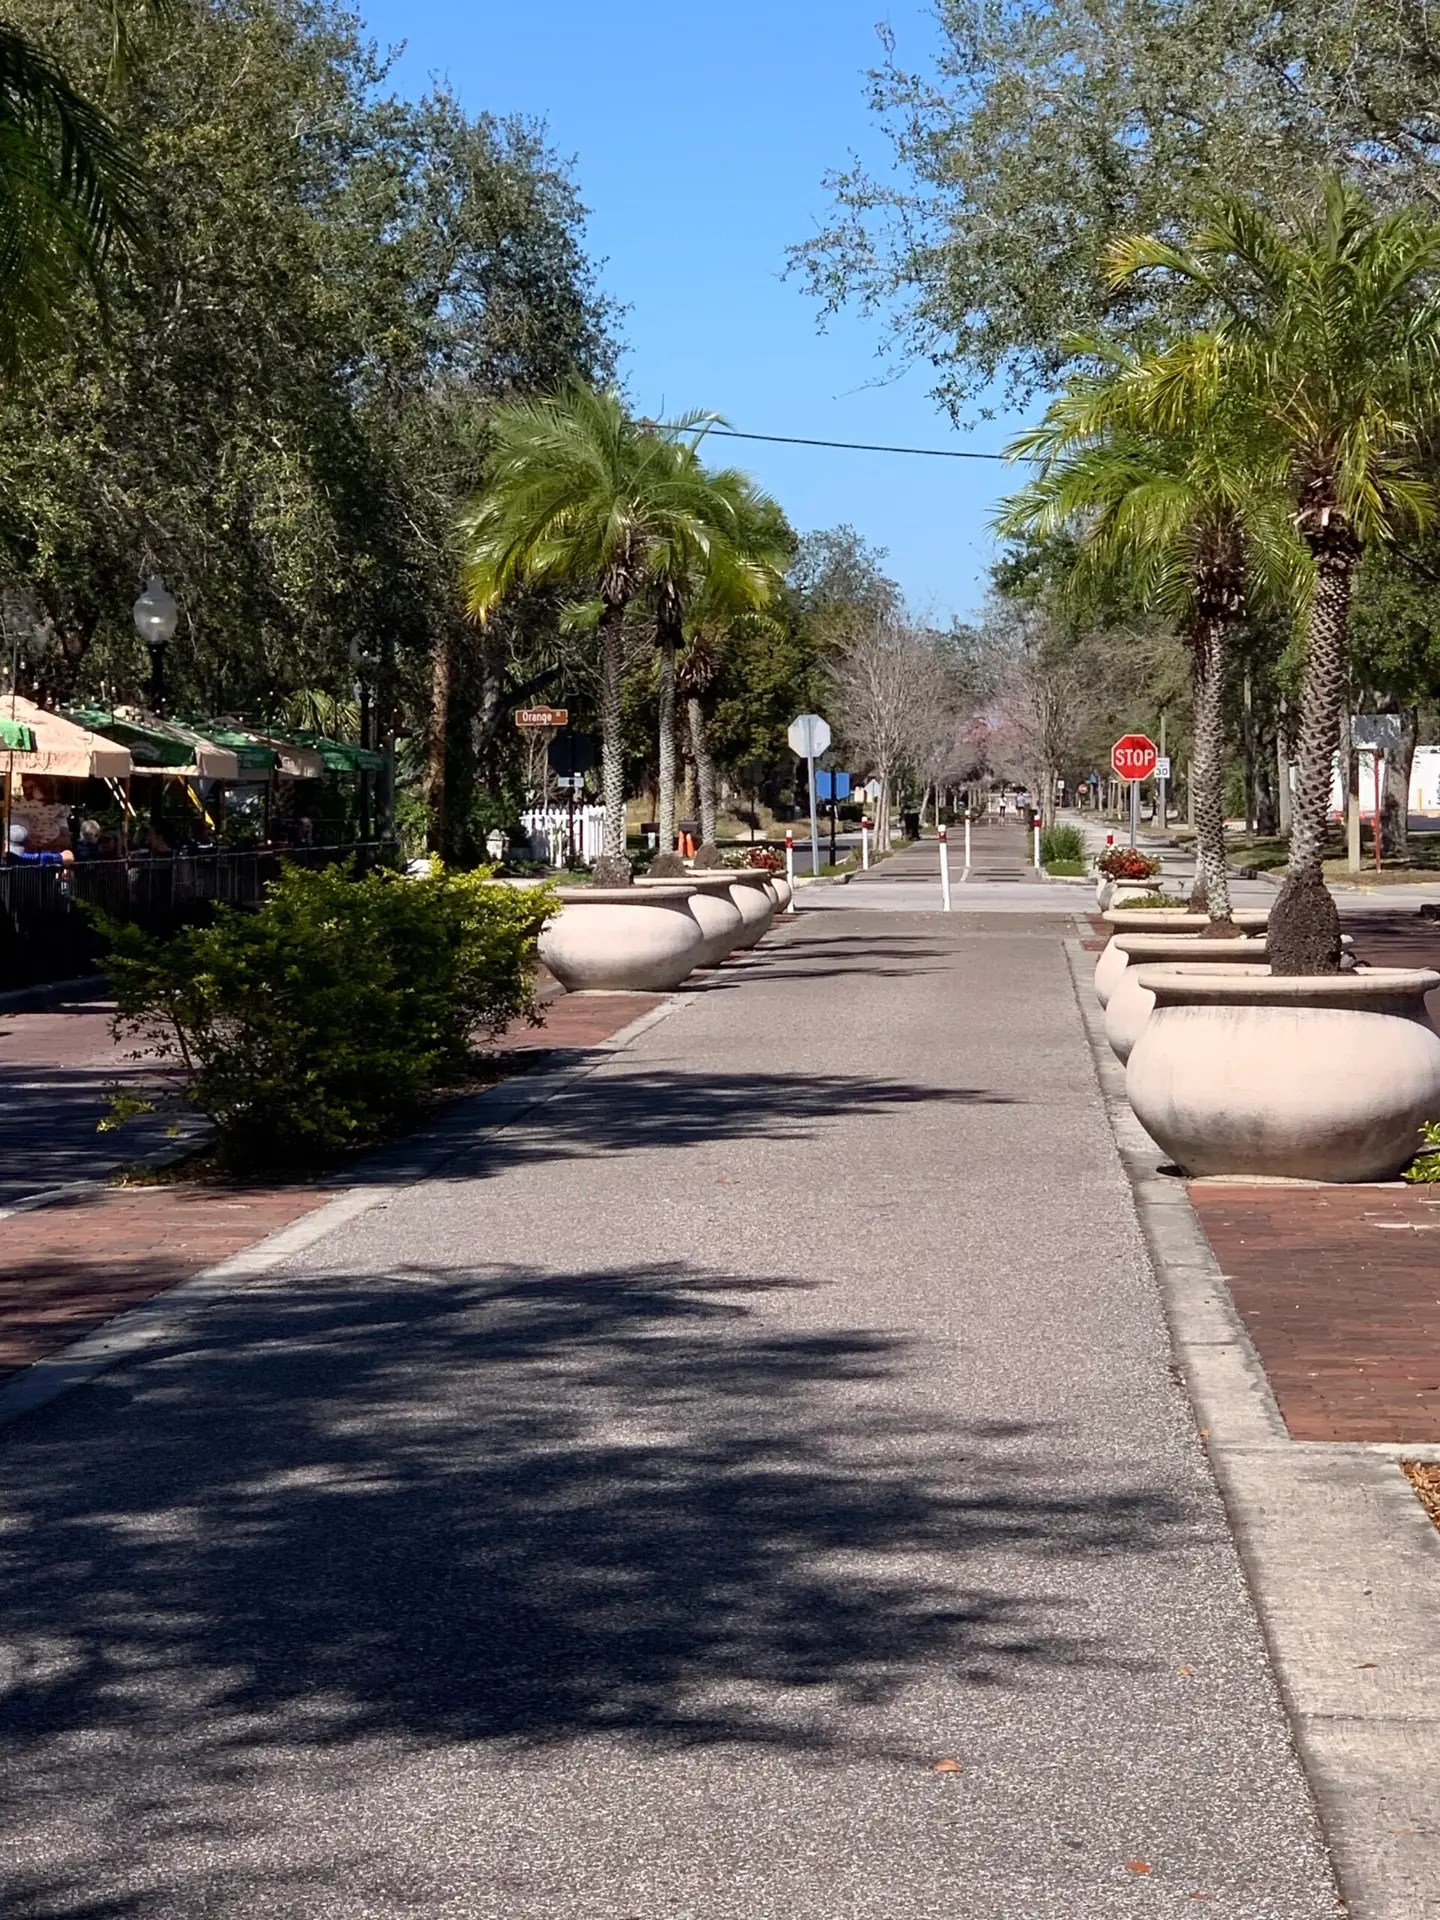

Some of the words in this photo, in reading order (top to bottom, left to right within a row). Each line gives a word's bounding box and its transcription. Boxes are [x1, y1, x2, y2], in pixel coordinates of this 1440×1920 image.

[523, 711, 552, 725] Orange
[1115, 749, 1154, 766] STOP
[1156, 768, 1168, 776] 30
